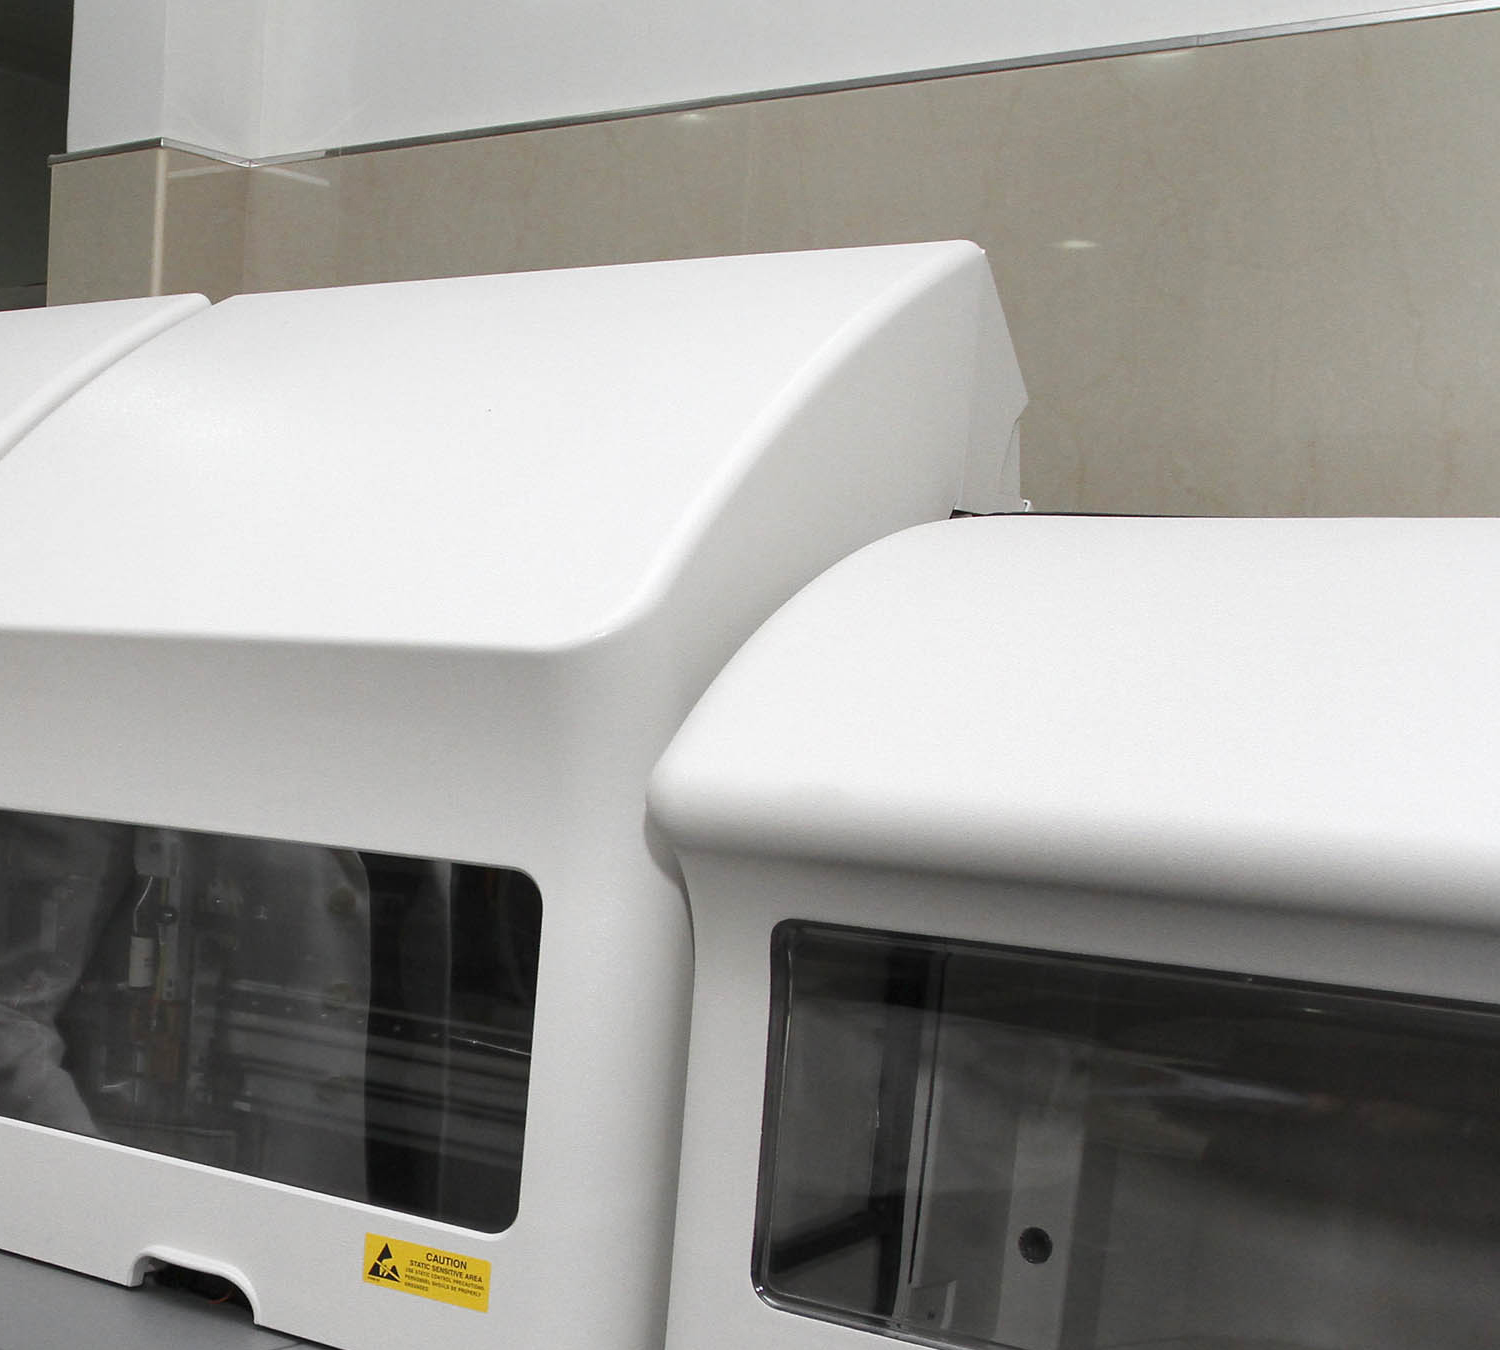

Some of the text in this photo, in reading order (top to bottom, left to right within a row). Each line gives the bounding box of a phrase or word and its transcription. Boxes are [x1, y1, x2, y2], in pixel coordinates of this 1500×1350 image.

[426, 1253, 467, 1270] CAUTION
[410, 1260, 482, 1283] STATIC SENSITIVE AREA
[415, 1269, 430, 1277] STATIC
